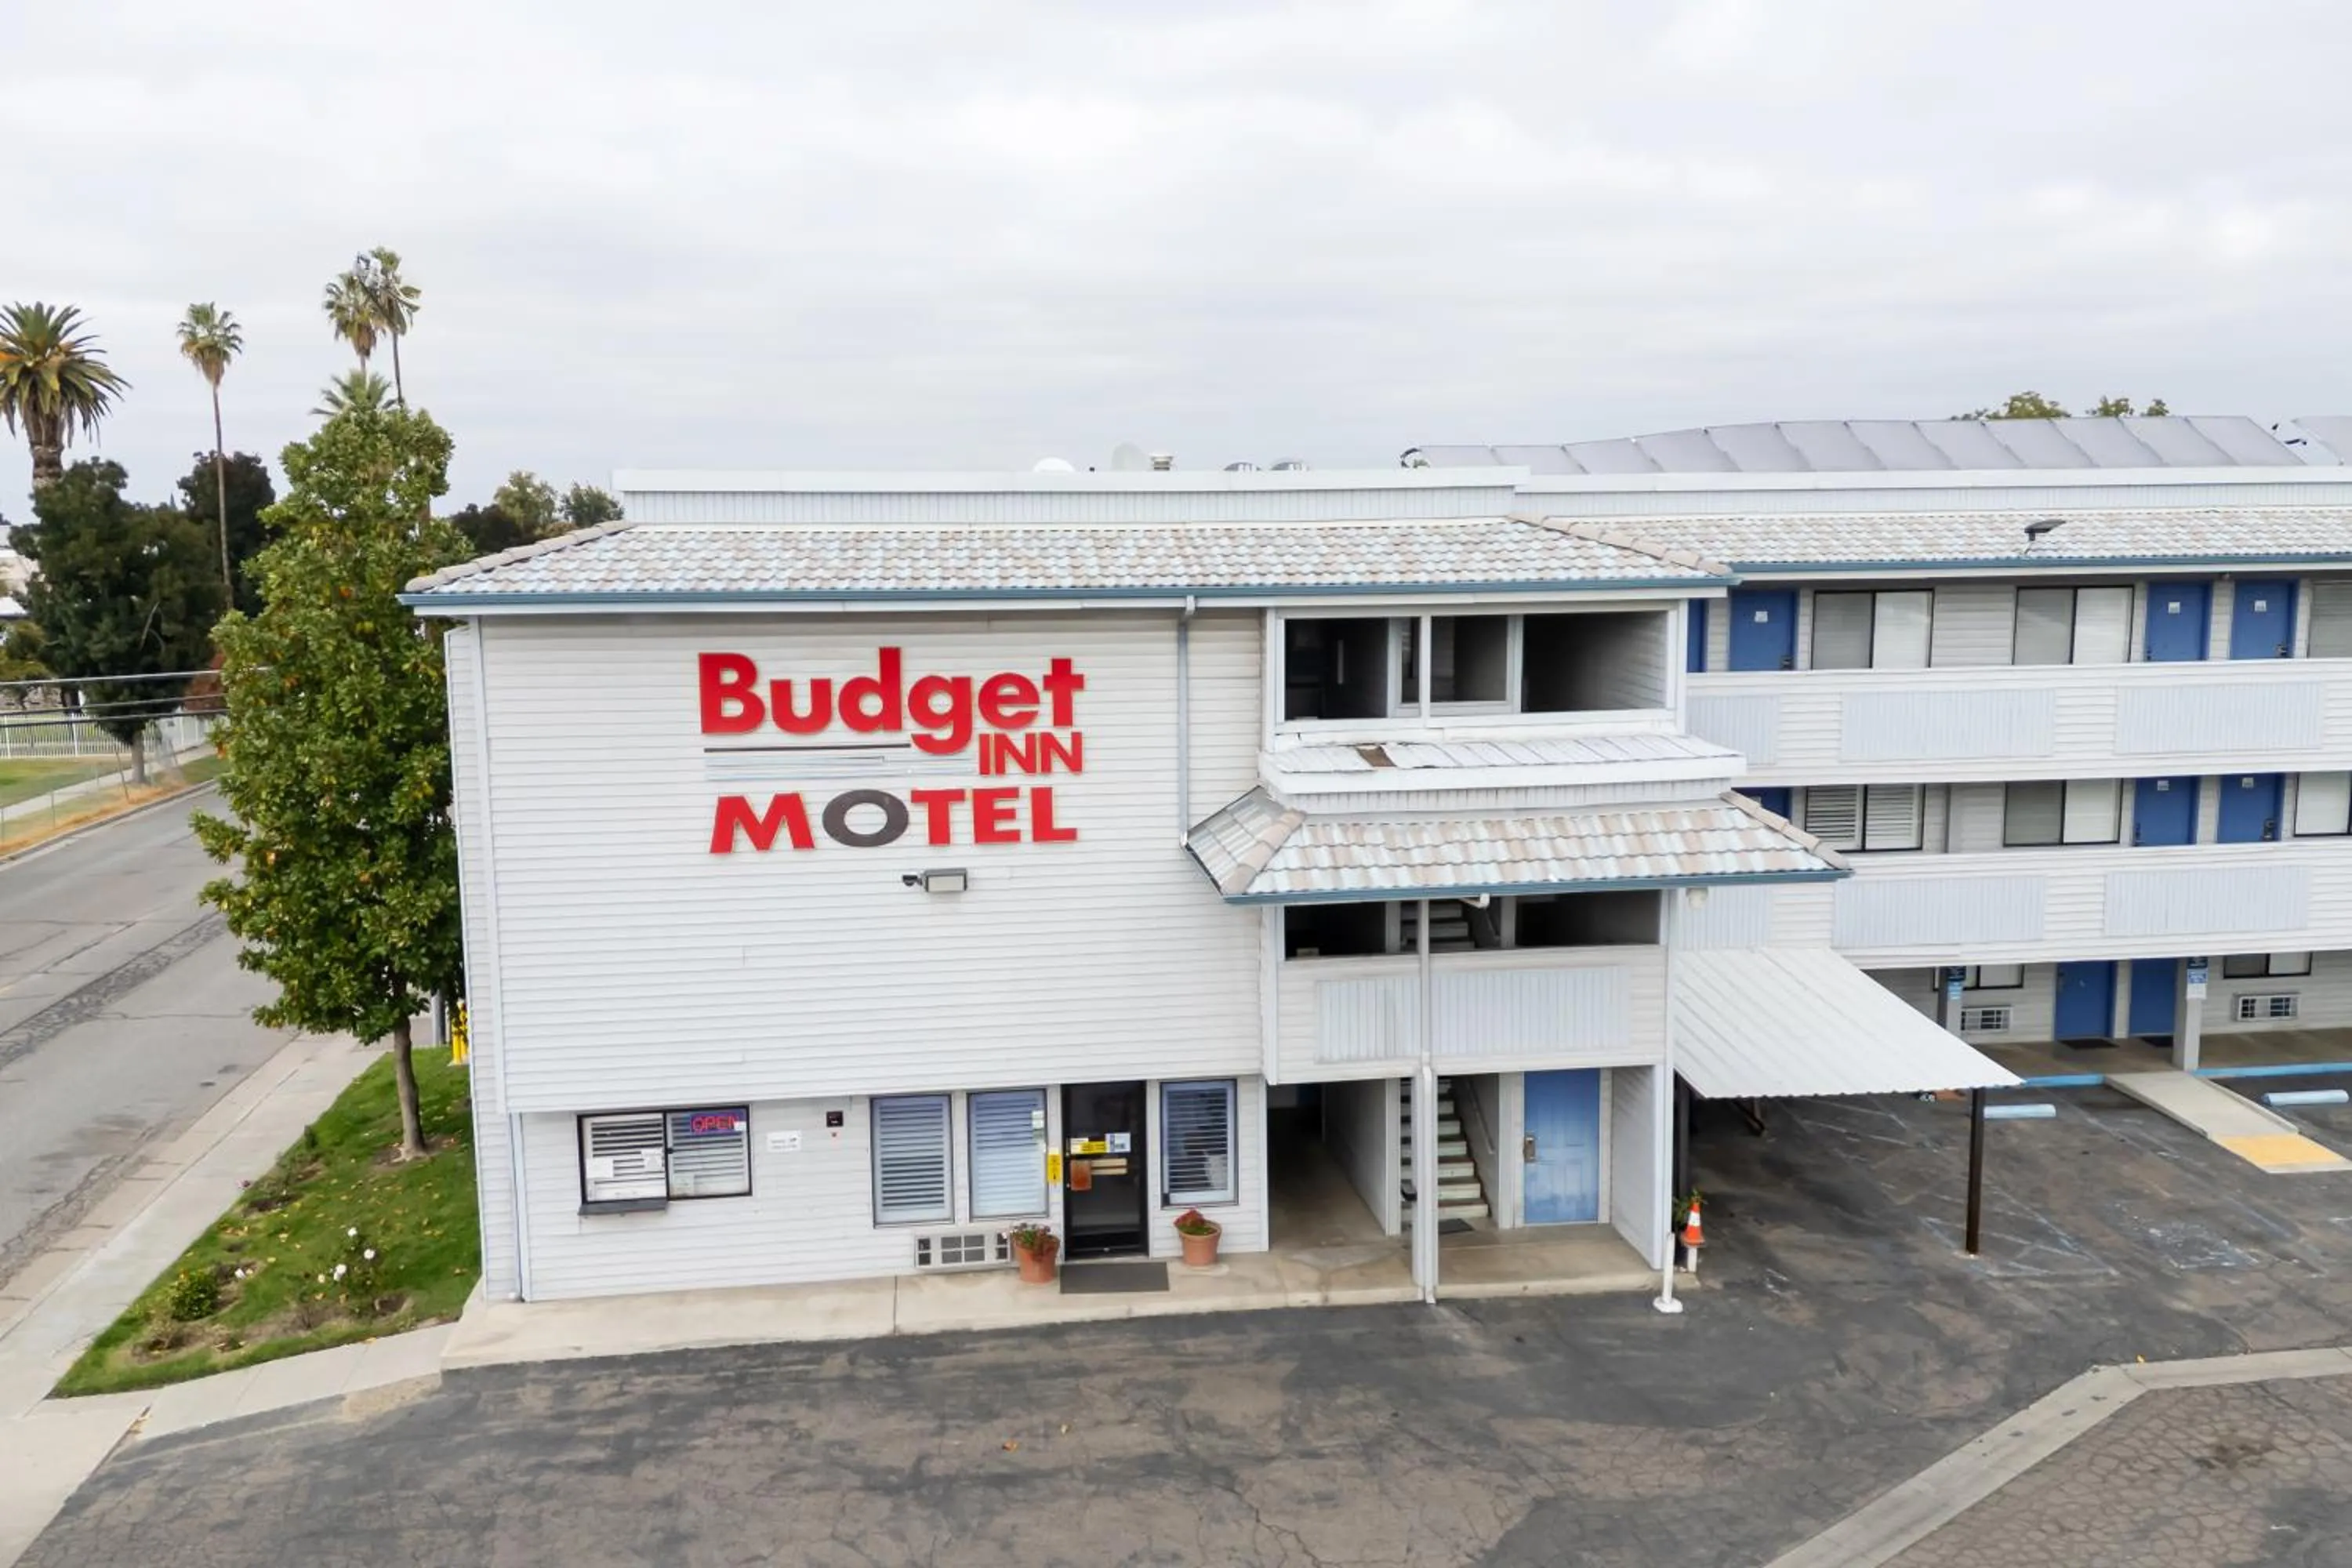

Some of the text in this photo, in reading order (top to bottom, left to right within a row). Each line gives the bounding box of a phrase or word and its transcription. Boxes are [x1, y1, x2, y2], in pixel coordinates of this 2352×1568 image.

[699, 647, 1084, 755] Budget
[978, 731, 1083, 775] INN
[710, 786, 1077, 854] MOTEL
[692, 1115, 739, 1133] OPEN
